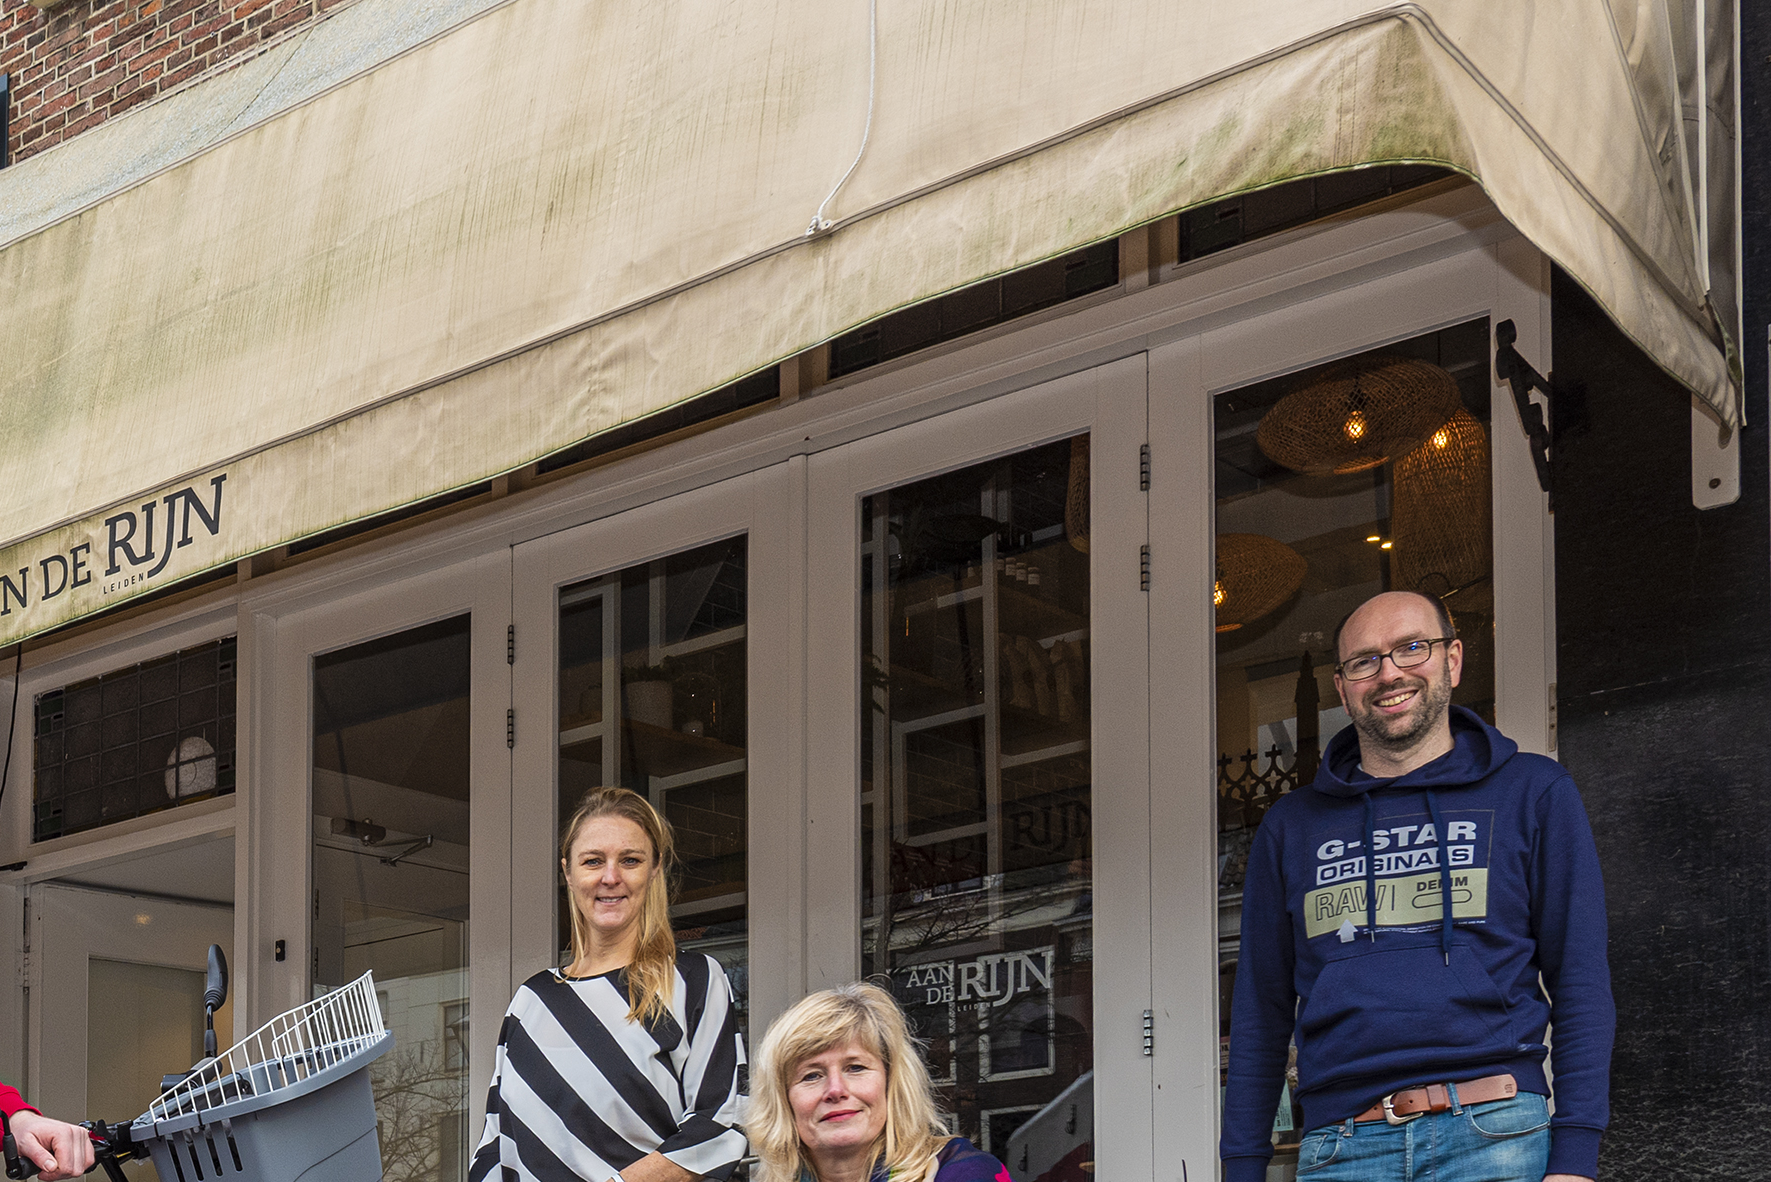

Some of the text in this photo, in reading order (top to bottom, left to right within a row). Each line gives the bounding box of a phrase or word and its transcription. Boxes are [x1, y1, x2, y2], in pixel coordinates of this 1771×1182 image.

[39, 542, 92, 601] DE
[104, 473, 227, 579] RIJN
[103, 572, 144, 595] LEIDEN
[1316, 821, 1477, 860] G-STAR
[1316, 885, 1386, 921] RAW
[906, 951, 1054, 1007] AAN RIJN
[926, 985, 954, 1005] DE
